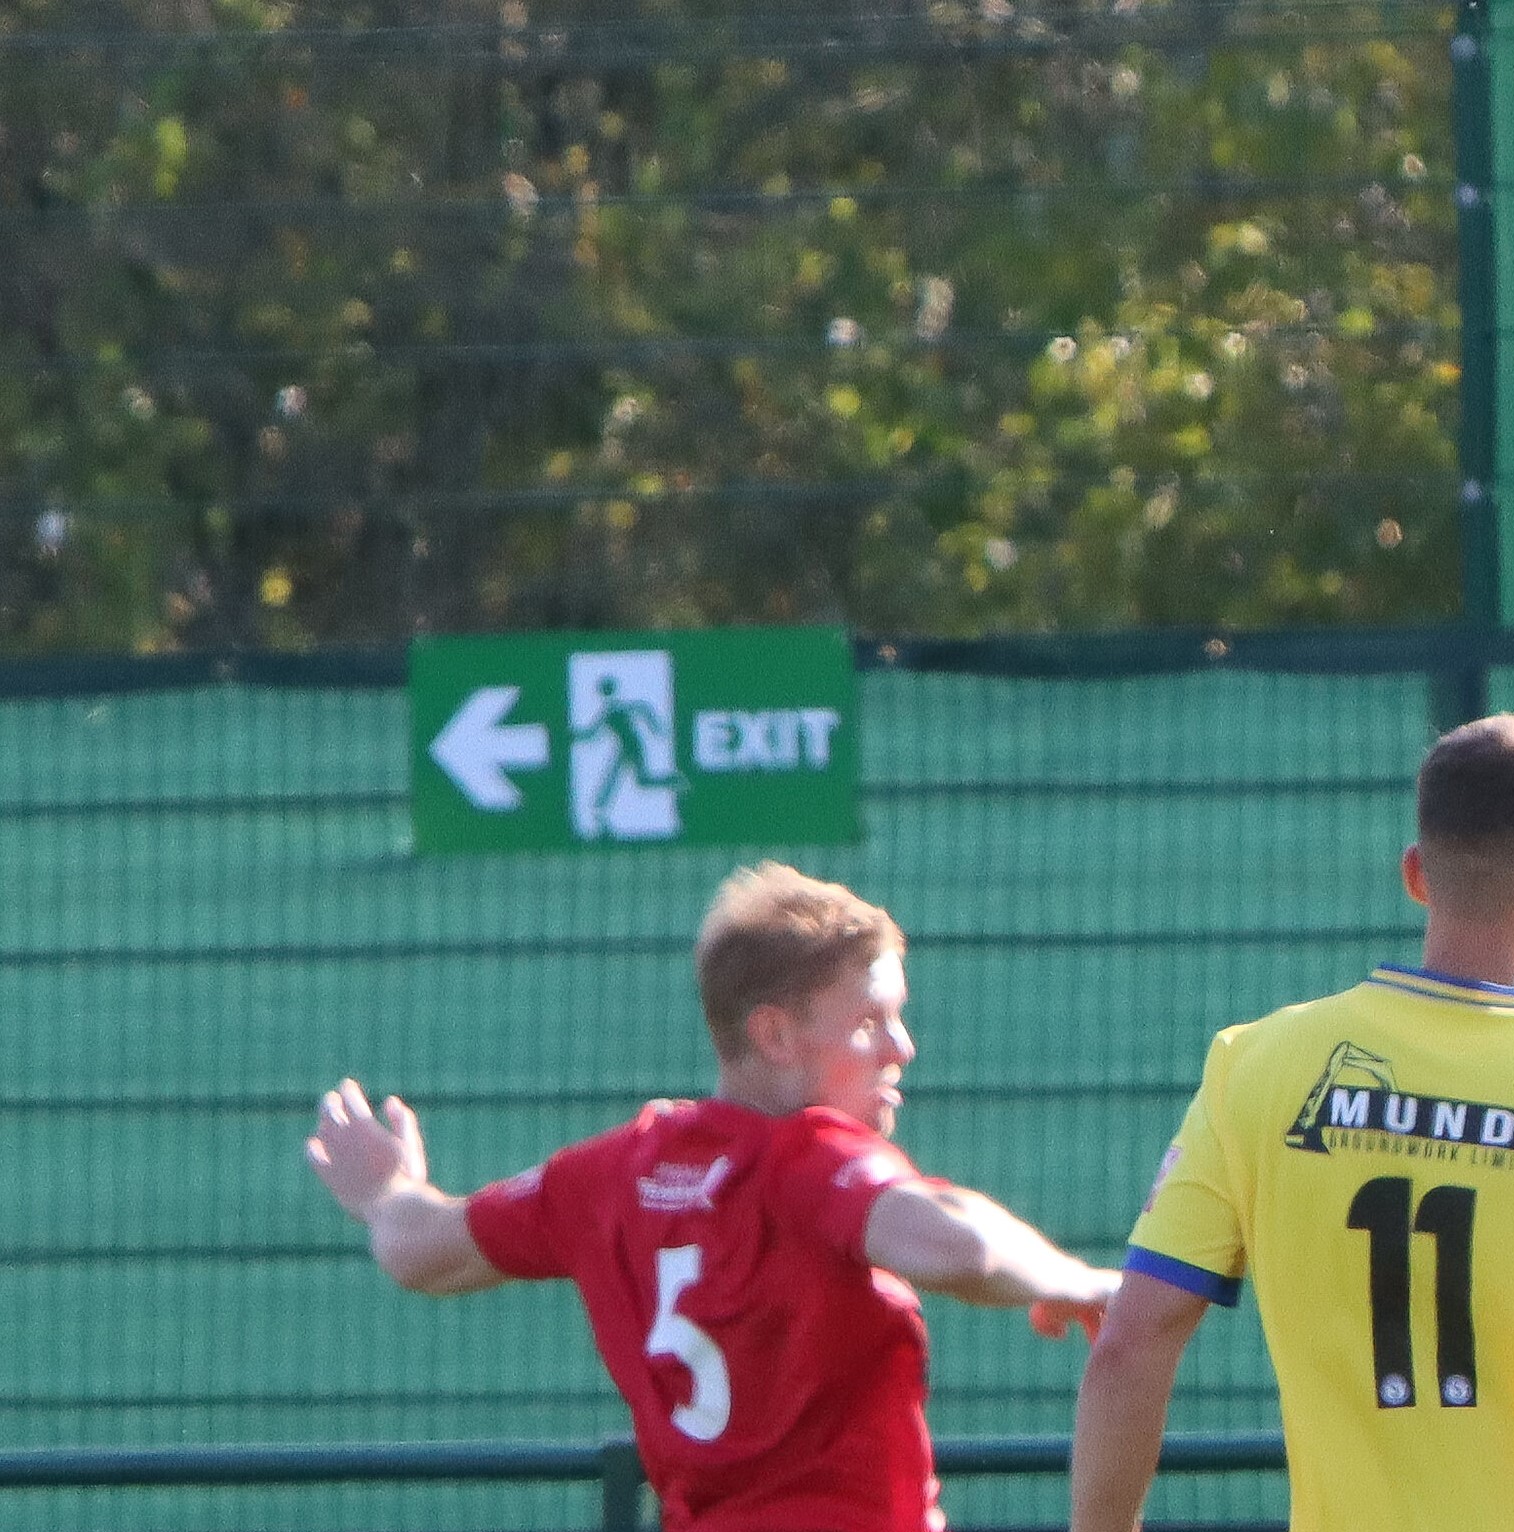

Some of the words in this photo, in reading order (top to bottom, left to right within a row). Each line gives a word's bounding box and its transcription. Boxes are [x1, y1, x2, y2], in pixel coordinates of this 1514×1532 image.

[694, 707, 840, 772] EXIT
[645, 1243, 732, 1441] 5
[1347, 1176, 1478, 1408] 11
